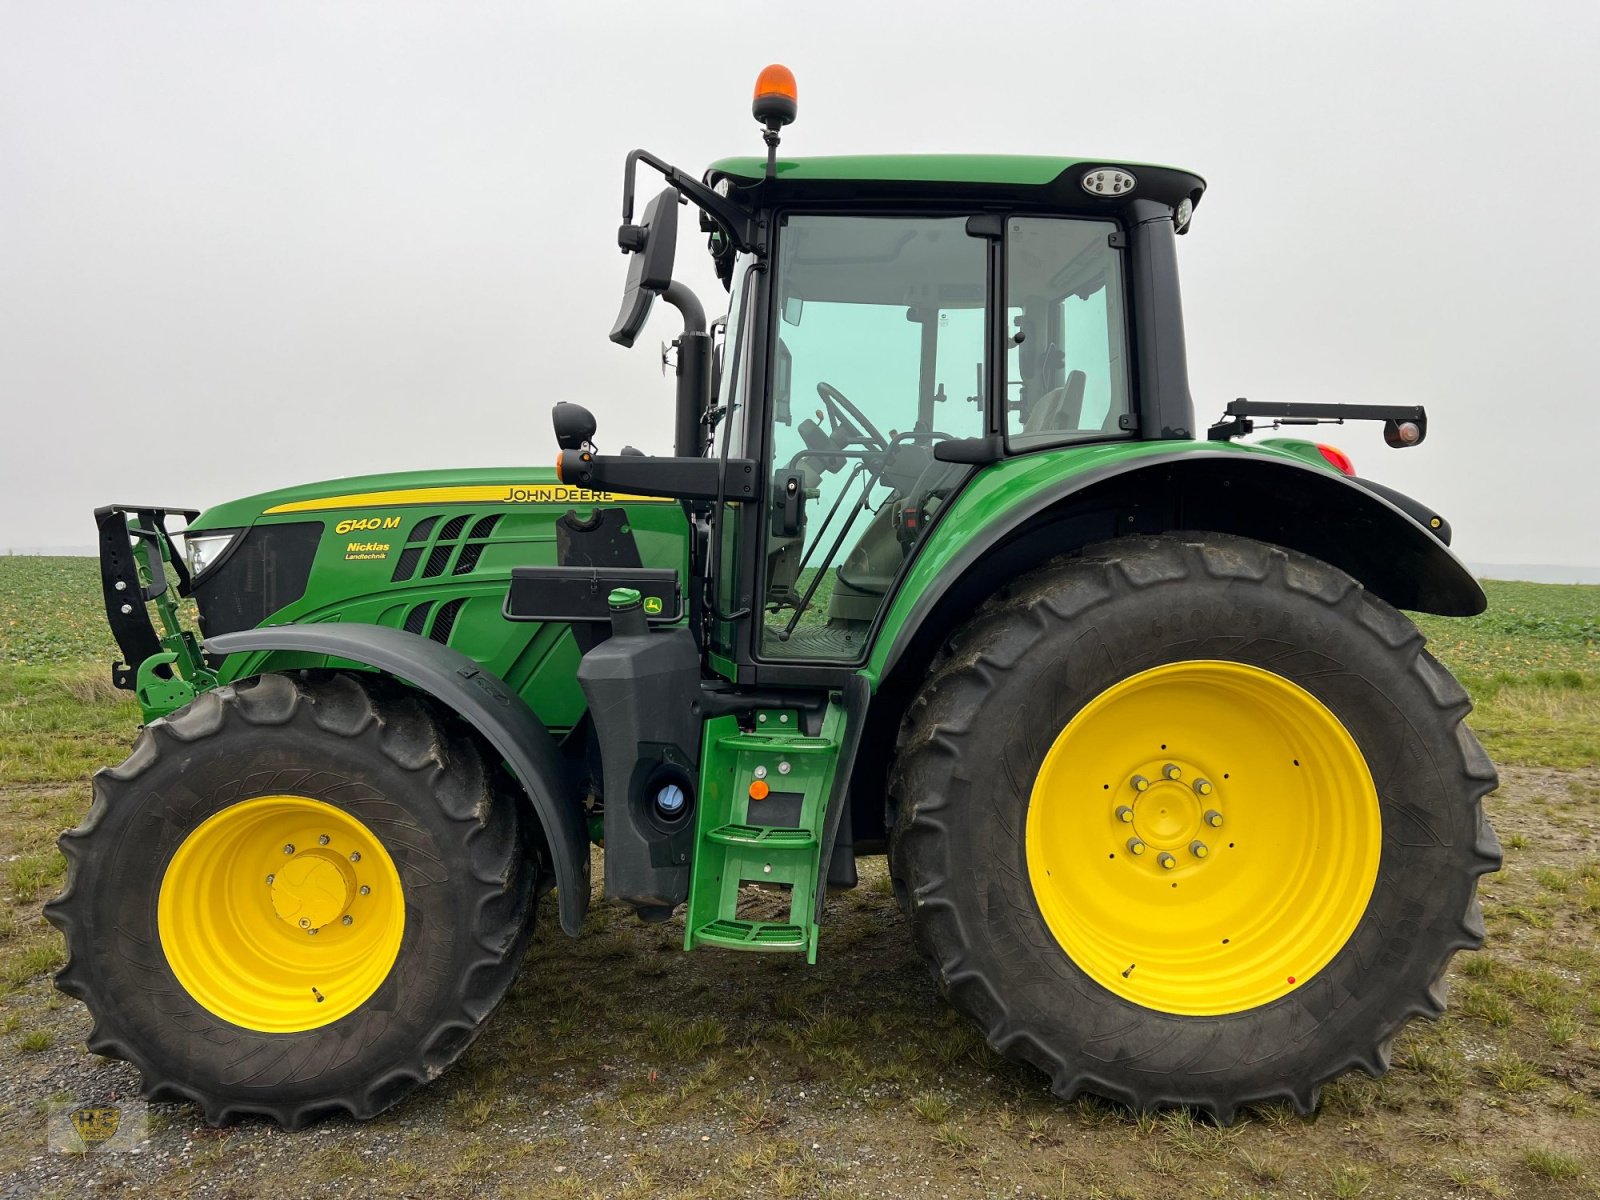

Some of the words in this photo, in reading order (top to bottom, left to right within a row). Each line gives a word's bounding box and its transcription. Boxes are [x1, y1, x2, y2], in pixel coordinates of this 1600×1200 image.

[503, 487, 551, 501] JOHN
[555, 487, 615, 501] DEERE
[335, 518, 382, 535] 6140
[382, 516, 401, 529] M
[346, 542, 390, 552] Nicklas
[345, 553, 387, 561] Landtechnik
